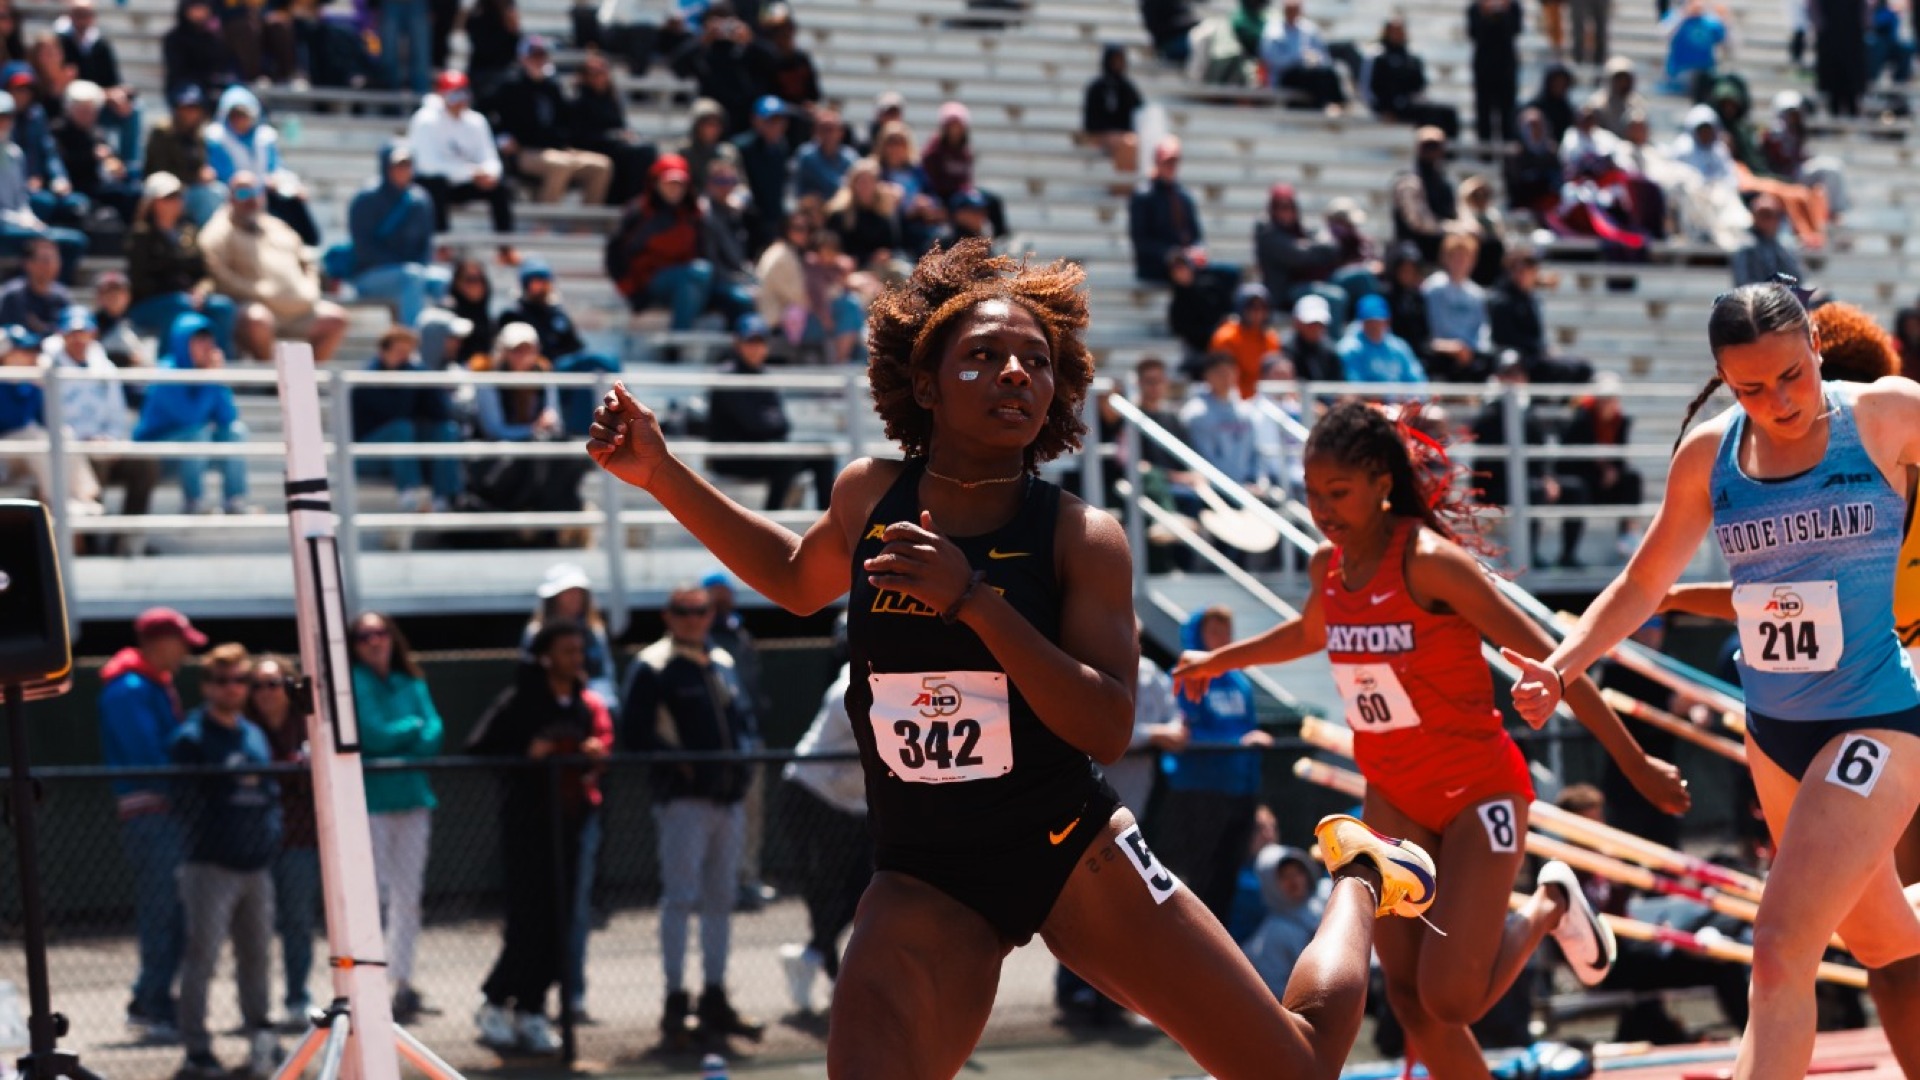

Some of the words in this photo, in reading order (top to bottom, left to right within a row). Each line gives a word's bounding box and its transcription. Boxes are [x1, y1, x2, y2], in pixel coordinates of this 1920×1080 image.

[1716, 517, 1777, 554] HODE
[1783, 503, 1874, 544] ISLAND
[1325, 624, 1413, 653] AYTON
[1758, 621, 1819, 661] 214
[1357, 693, 1391, 724] 60
[893, 718, 984, 769] 342
[1837, 739, 1879, 786] 6
[1487, 804, 1513, 848] 8
[1125, 831, 1173, 891] 5
